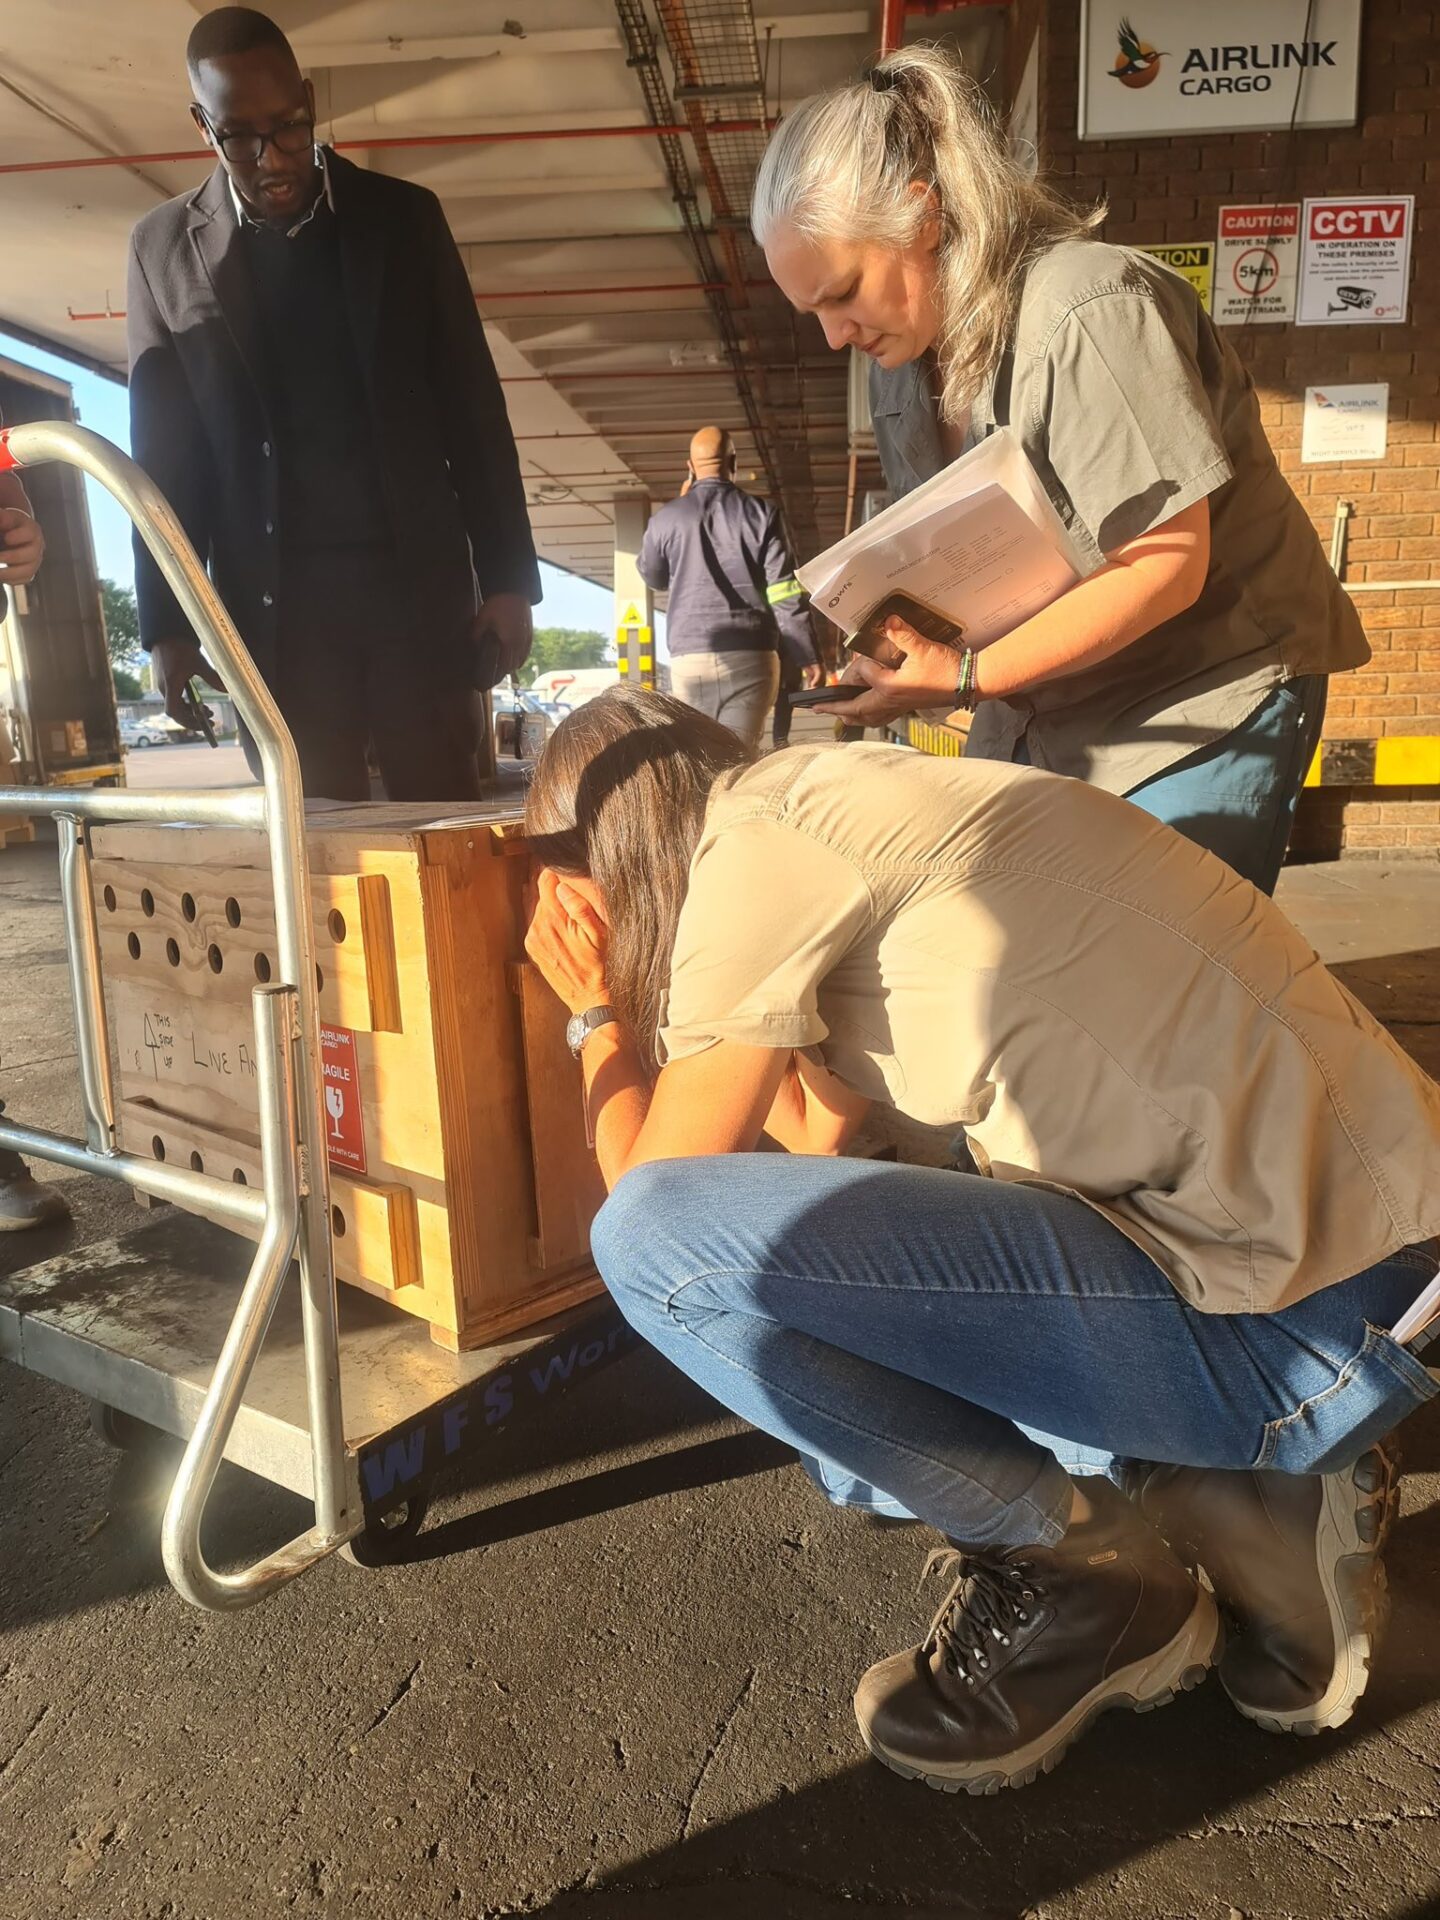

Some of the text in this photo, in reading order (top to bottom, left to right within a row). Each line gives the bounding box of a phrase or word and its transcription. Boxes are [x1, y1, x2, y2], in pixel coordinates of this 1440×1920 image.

[1181, 41, 1338, 73] AIRLINK
[1180, 75, 1271, 96] CARGO
[1225, 215, 1295, 229] CAUTION
[1314, 209, 1402, 235] CCTV
[1224, 238, 1252, 246] DRIVE
[1328, 241, 1380, 249] OPERATION
[1382, 240, 1396, 248] ON
[1349, 250, 1395, 258] PREMISES
[1263, 296, 1282, 304] FOR
[322, 1063, 351, 1082] RAGILE
[528, 1324, 630, 1394] Wor
